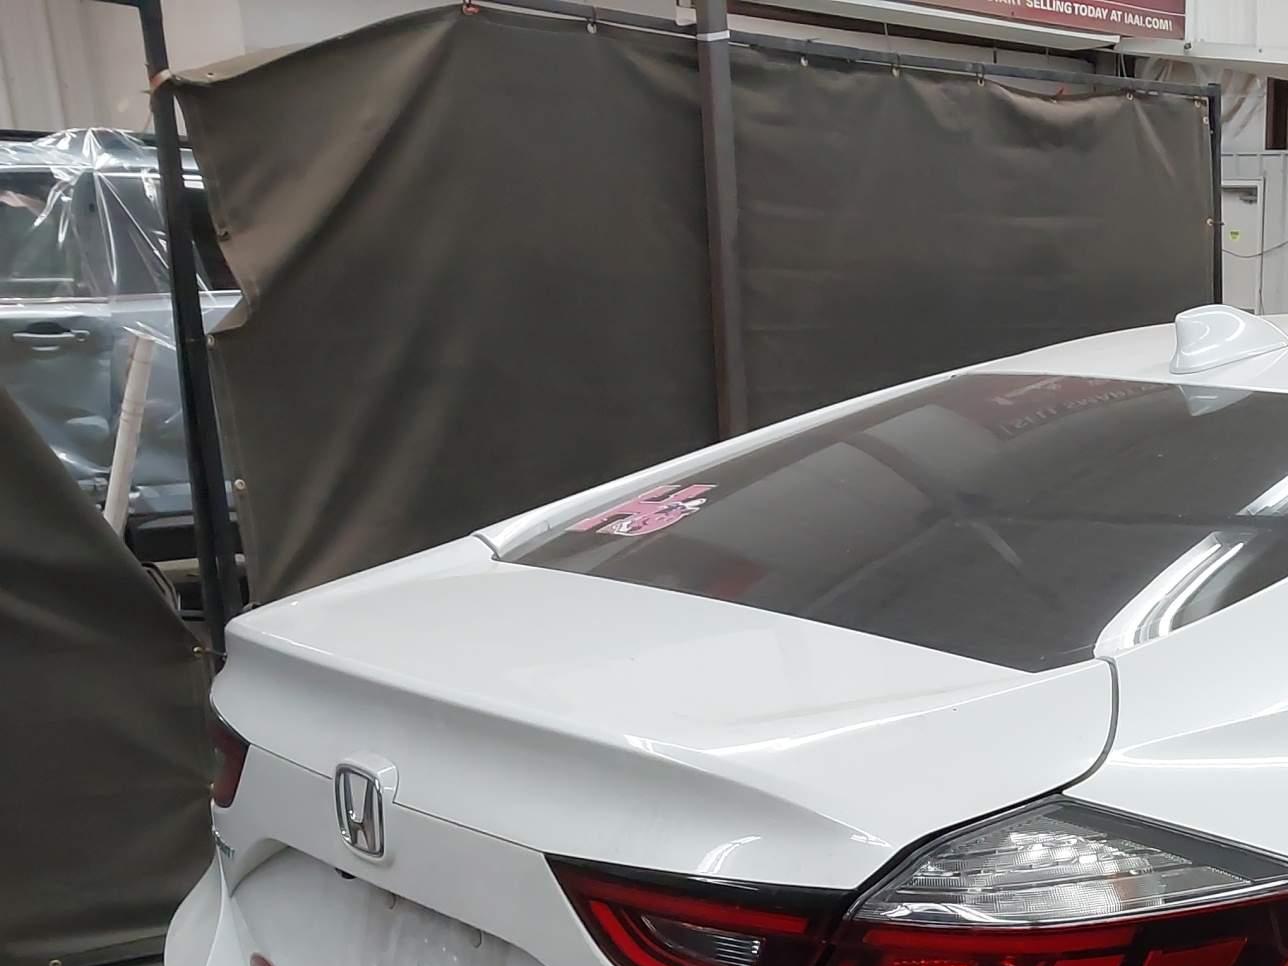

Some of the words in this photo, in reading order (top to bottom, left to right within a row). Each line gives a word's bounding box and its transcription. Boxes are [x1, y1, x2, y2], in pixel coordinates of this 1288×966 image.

[1026, 0, 1077, 14] SELLING
[1074, 3, 1109, 20] TODAY
[1110, 11, 1124, 24] AT
[1124, 13, 1174, 31] IAAI.COM!
